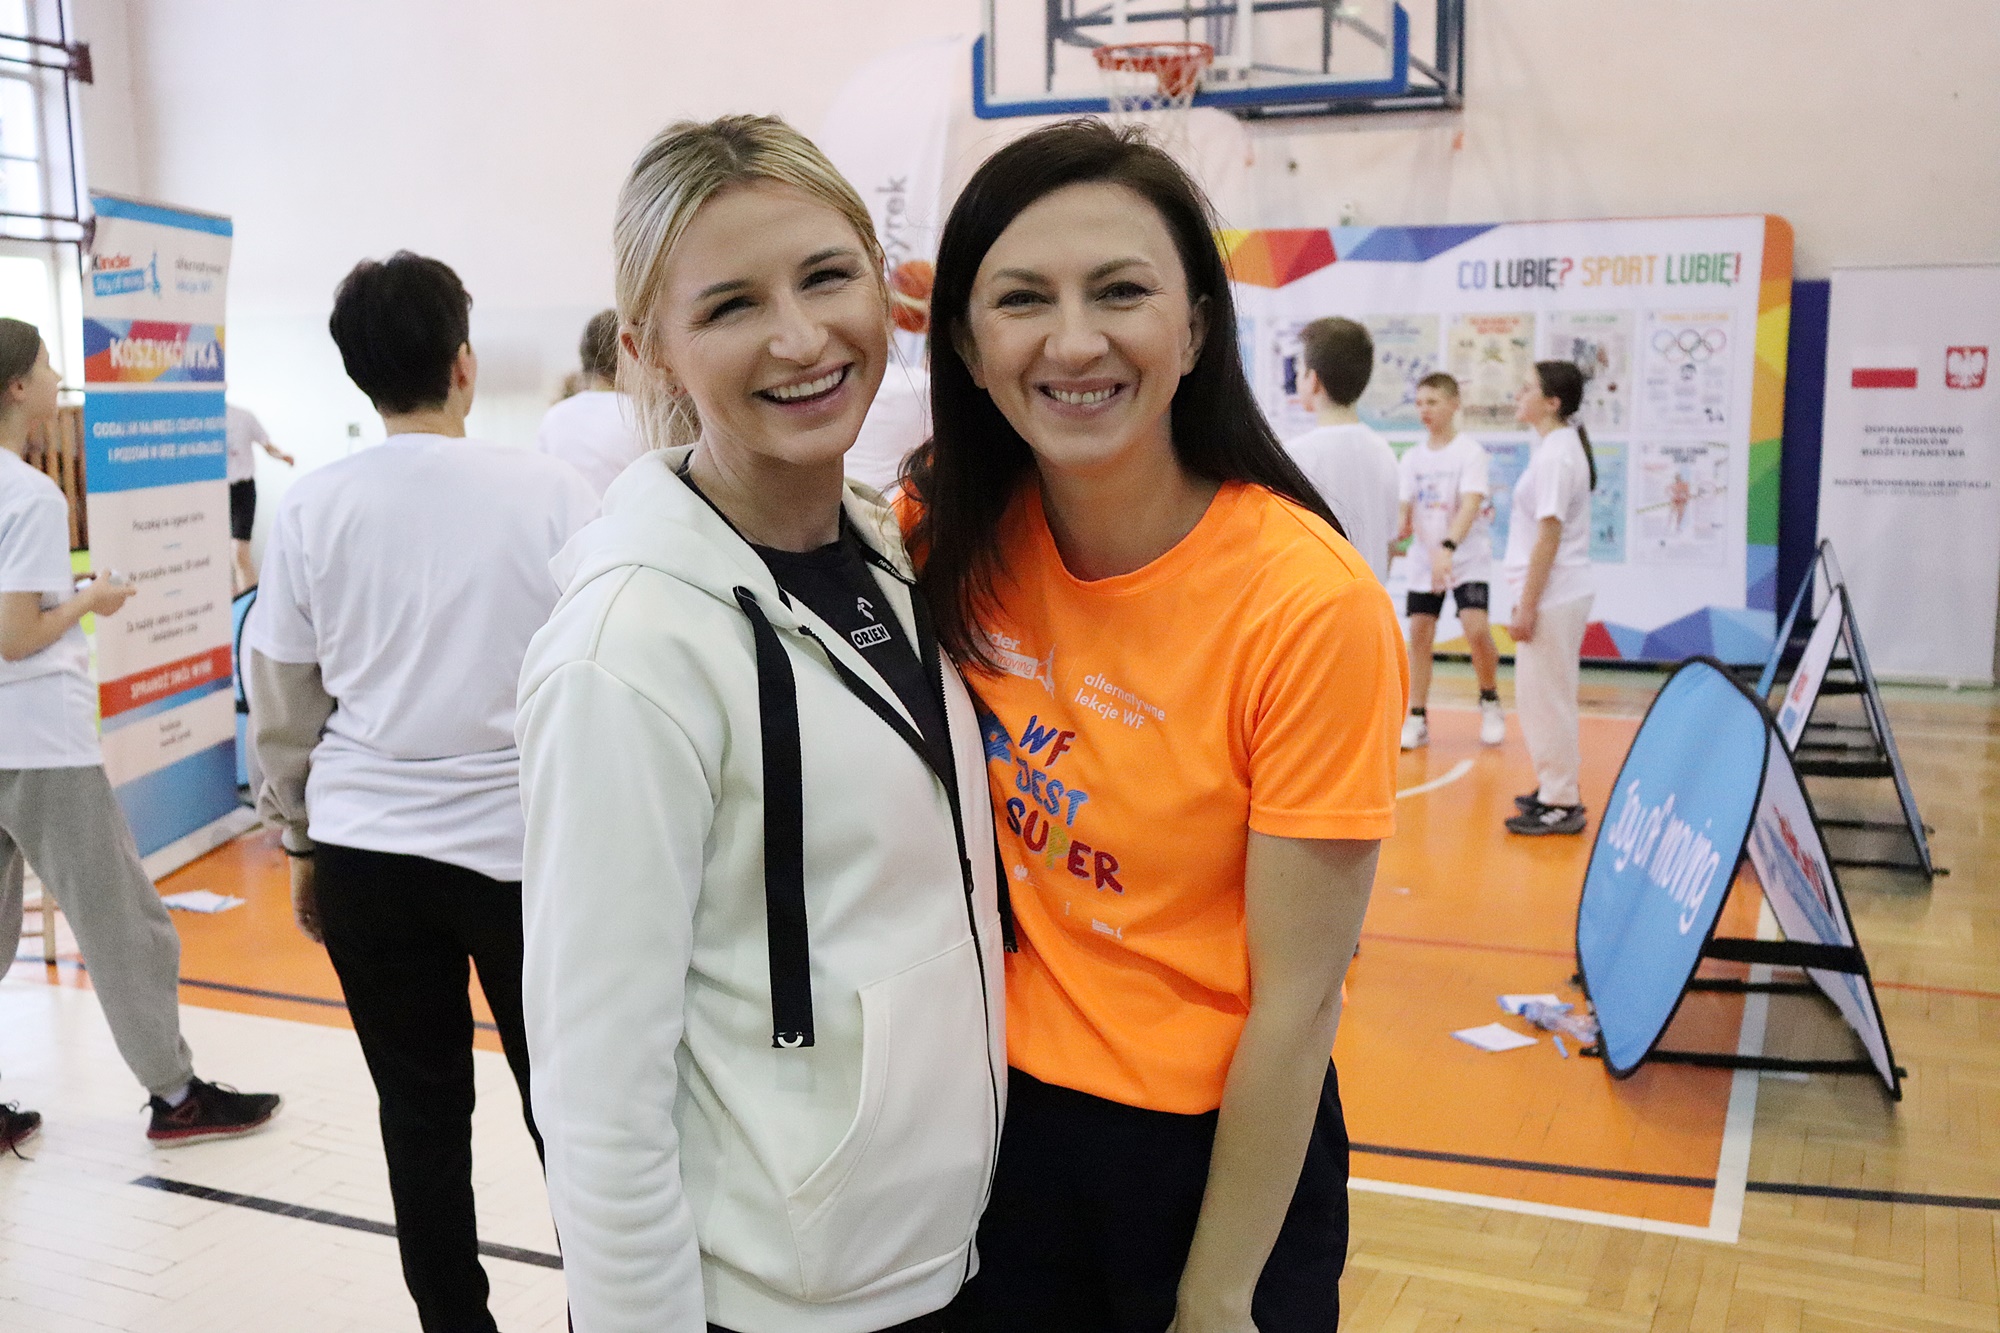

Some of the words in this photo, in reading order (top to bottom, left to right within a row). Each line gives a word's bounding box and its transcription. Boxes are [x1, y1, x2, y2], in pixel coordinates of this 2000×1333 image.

[1458, 260, 1487, 289] CO
[1494, 257, 1574, 291] LUBIĘ?
[1581, 255, 1658, 287] SPORT
[1665, 252, 1742, 287] LUBIĘ!
[1074, 688, 1119, 719] lekcje
[1123, 709, 1145, 729] WF
[1084, 673, 1165, 720] alternatywne
[1019, 715, 1076, 768] WF
[1015, 756, 1088, 827] JEST
[1007, 797, 1125, 895] SUPER
